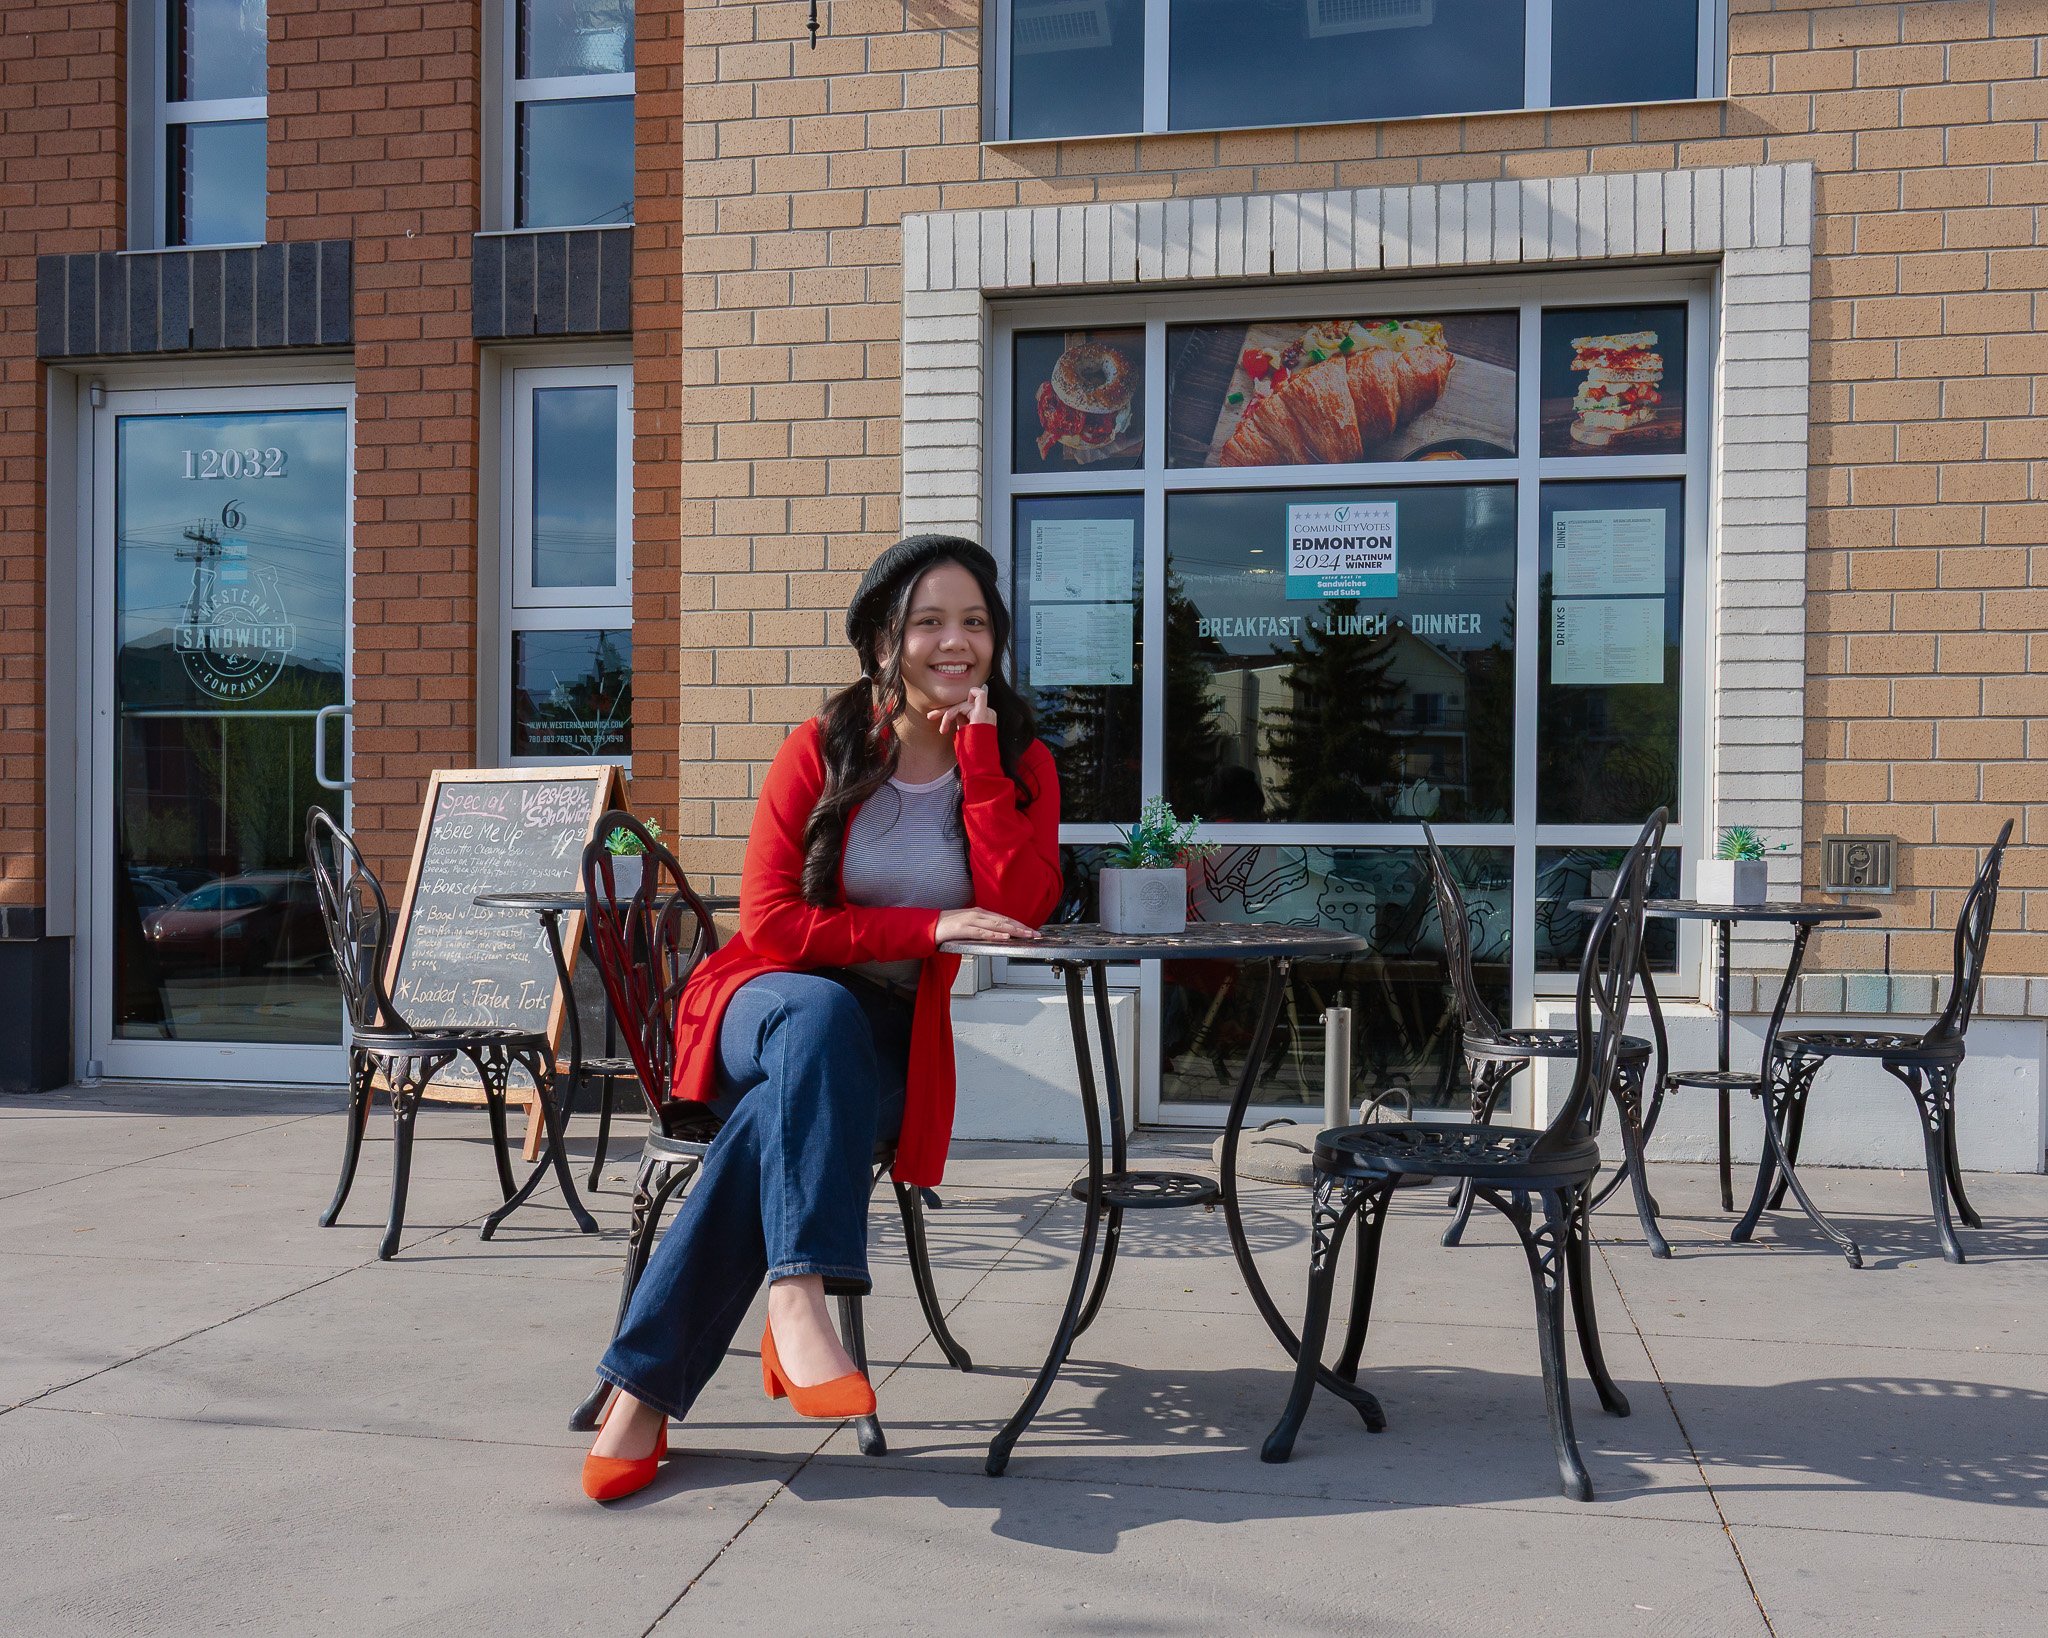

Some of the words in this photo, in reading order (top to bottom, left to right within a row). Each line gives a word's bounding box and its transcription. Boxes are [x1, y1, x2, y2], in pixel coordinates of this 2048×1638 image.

[181, 447, 283, 479] 12032
[221, 499, 240, 529] 6
[1292, 536, 1392, 551] EDMONTON
[1557, 521, 1566, 549] DINNER
[1293, 554, 1341, 571] 2024
[1345, 561, 1382, 569] WINNER
[1317, 580, 1367, 588] Sandwiches
[1340, 588, 1361, 596] Subs
[200, 588, 270, 618] WESTERN
[1035, 611, 1043, 628] LUNCH
[1199, 616, 1301, 638] BREAKFAST
[1326, 615, 1387, 636] LUNCH
[1412, 614, 1481, 634] DINNER
[1556, 606, 1566, 646] DRINKS
[183, 627, 286, 649] SANDWICH
[203, 672, 264, 695] COMPANY
